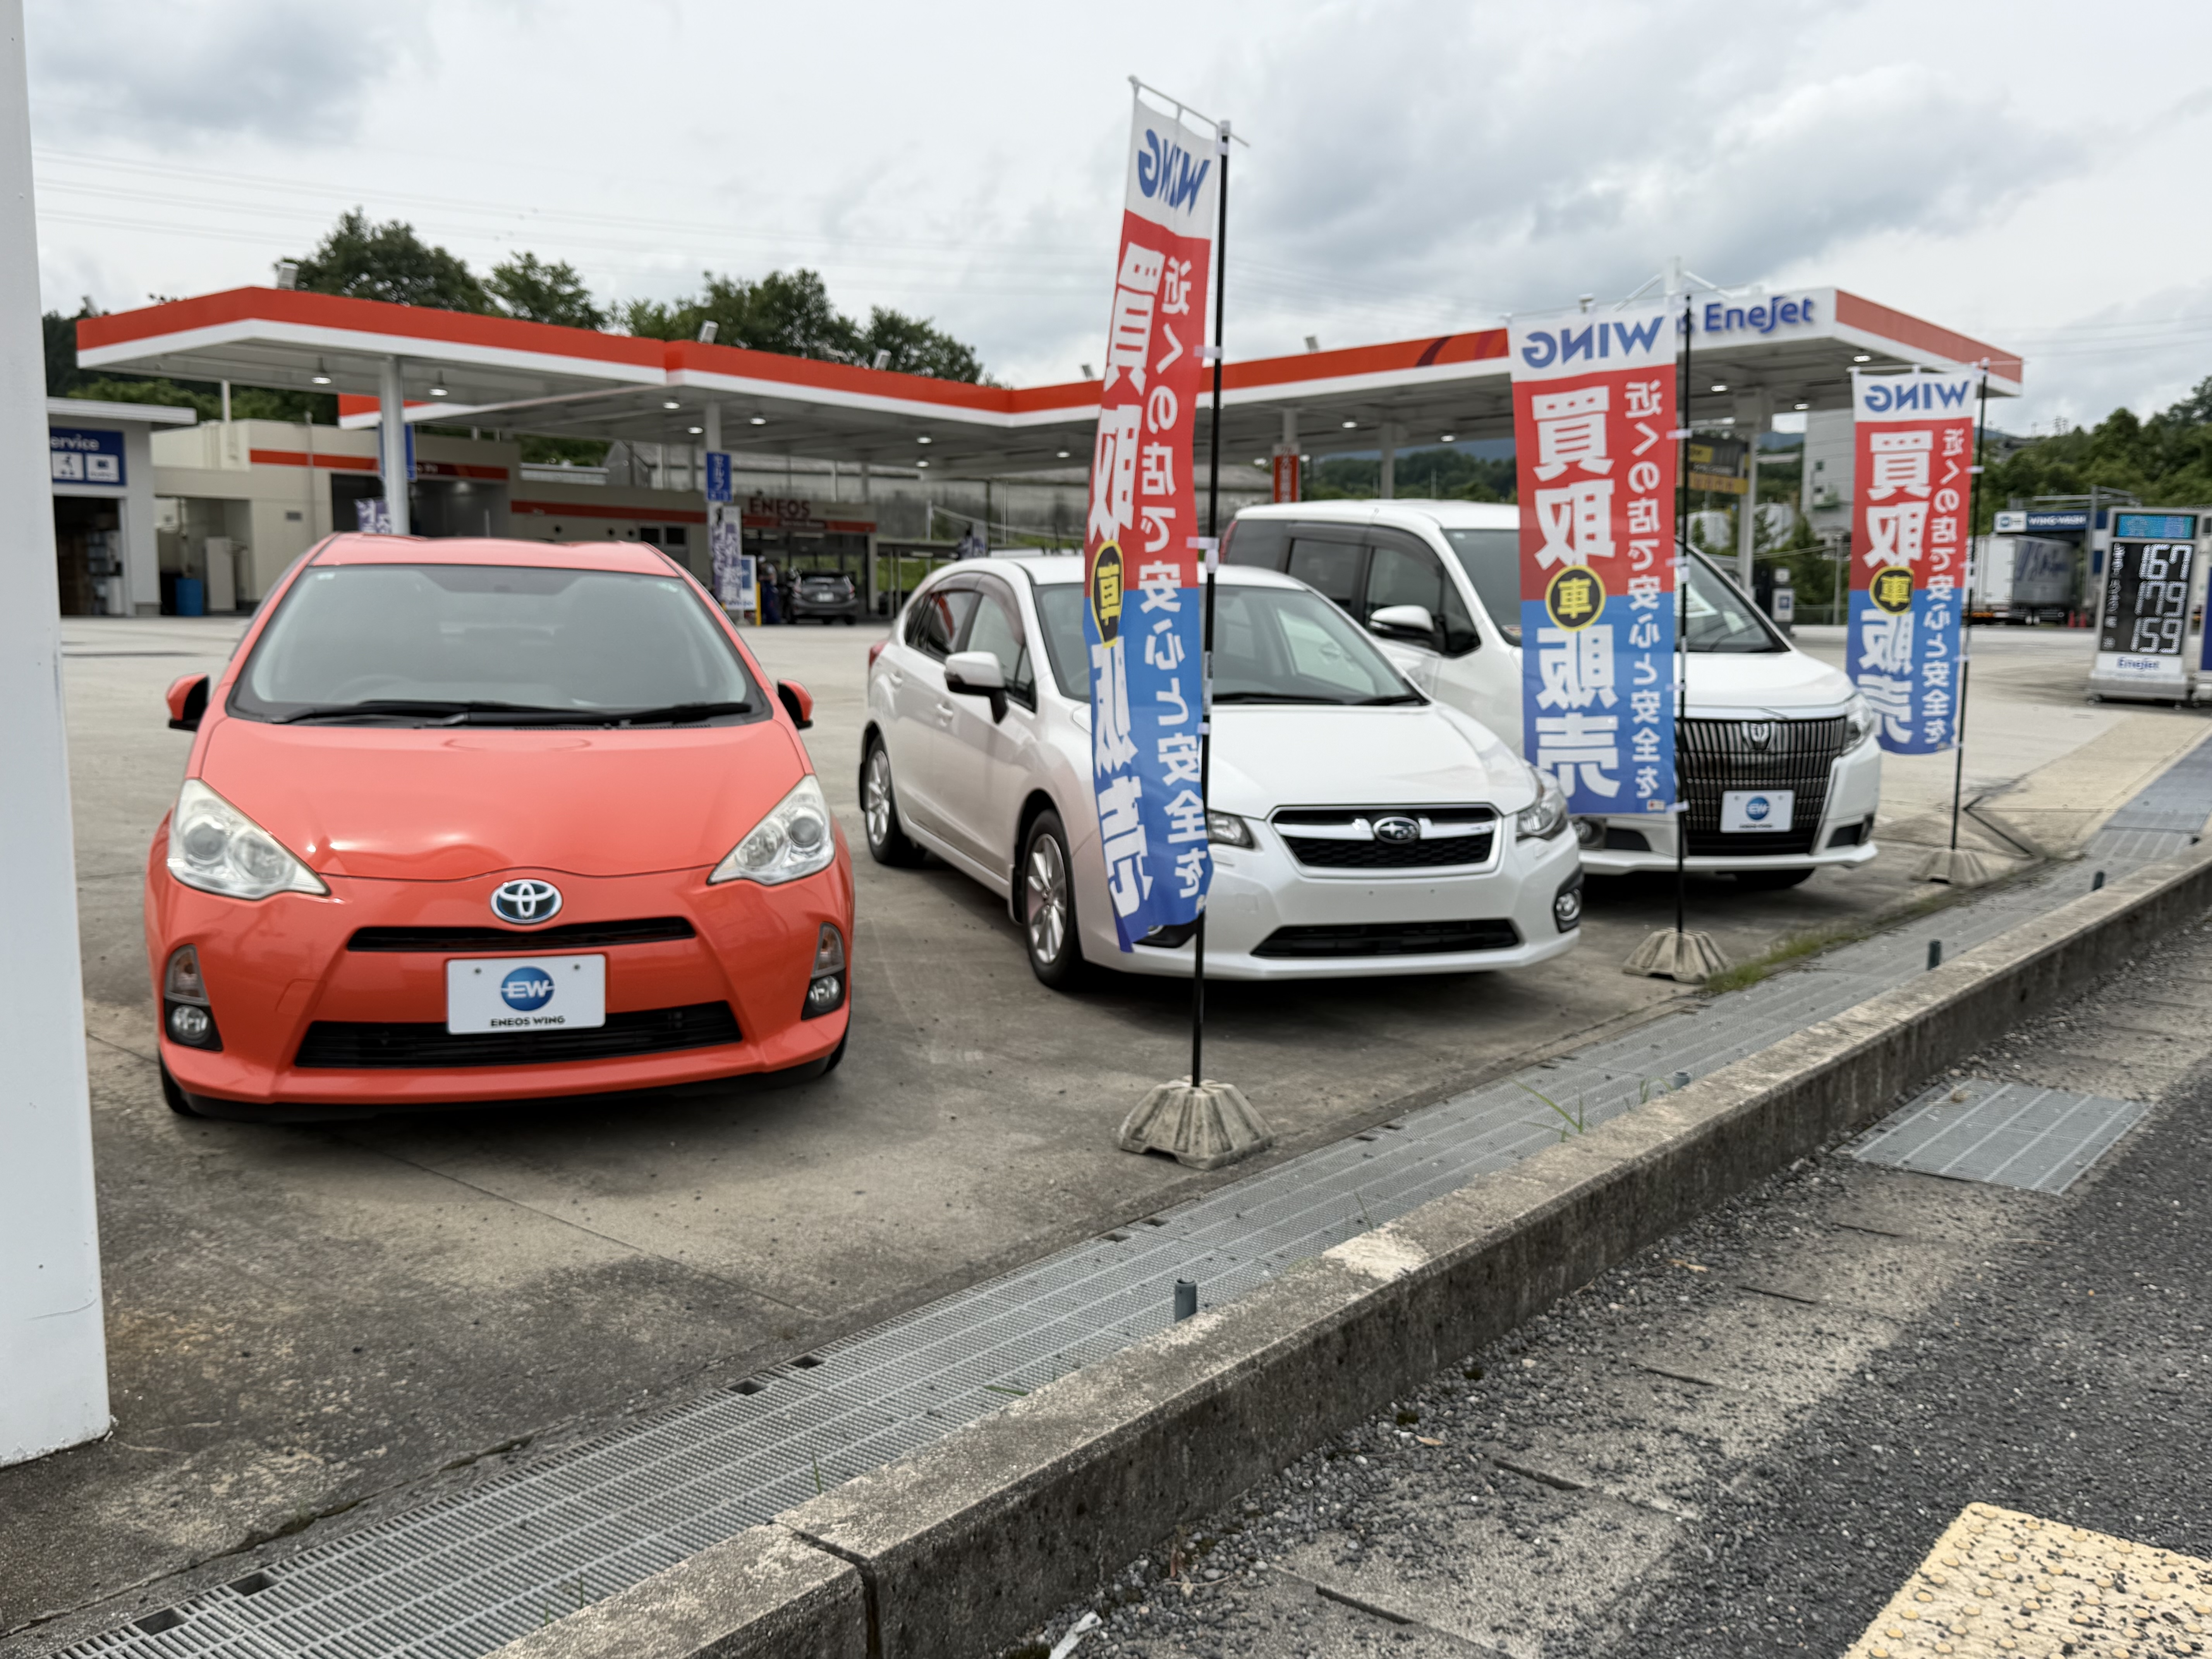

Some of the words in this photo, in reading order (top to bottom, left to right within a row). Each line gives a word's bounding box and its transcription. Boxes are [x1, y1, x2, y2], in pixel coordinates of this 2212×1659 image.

[50, 433, 100, 451] ervice
[750, 497, 811, 518] ENEOS
[2139, 544, 2193, 580] 167
[2134, 580, 2188, 618] 179
[2130, 617, 2184, 654] 159
[507, 979, 551, 999] EW
[490, 1017, 531, 1027] ENEOS
[534, 1015, 565, 1025] WING
